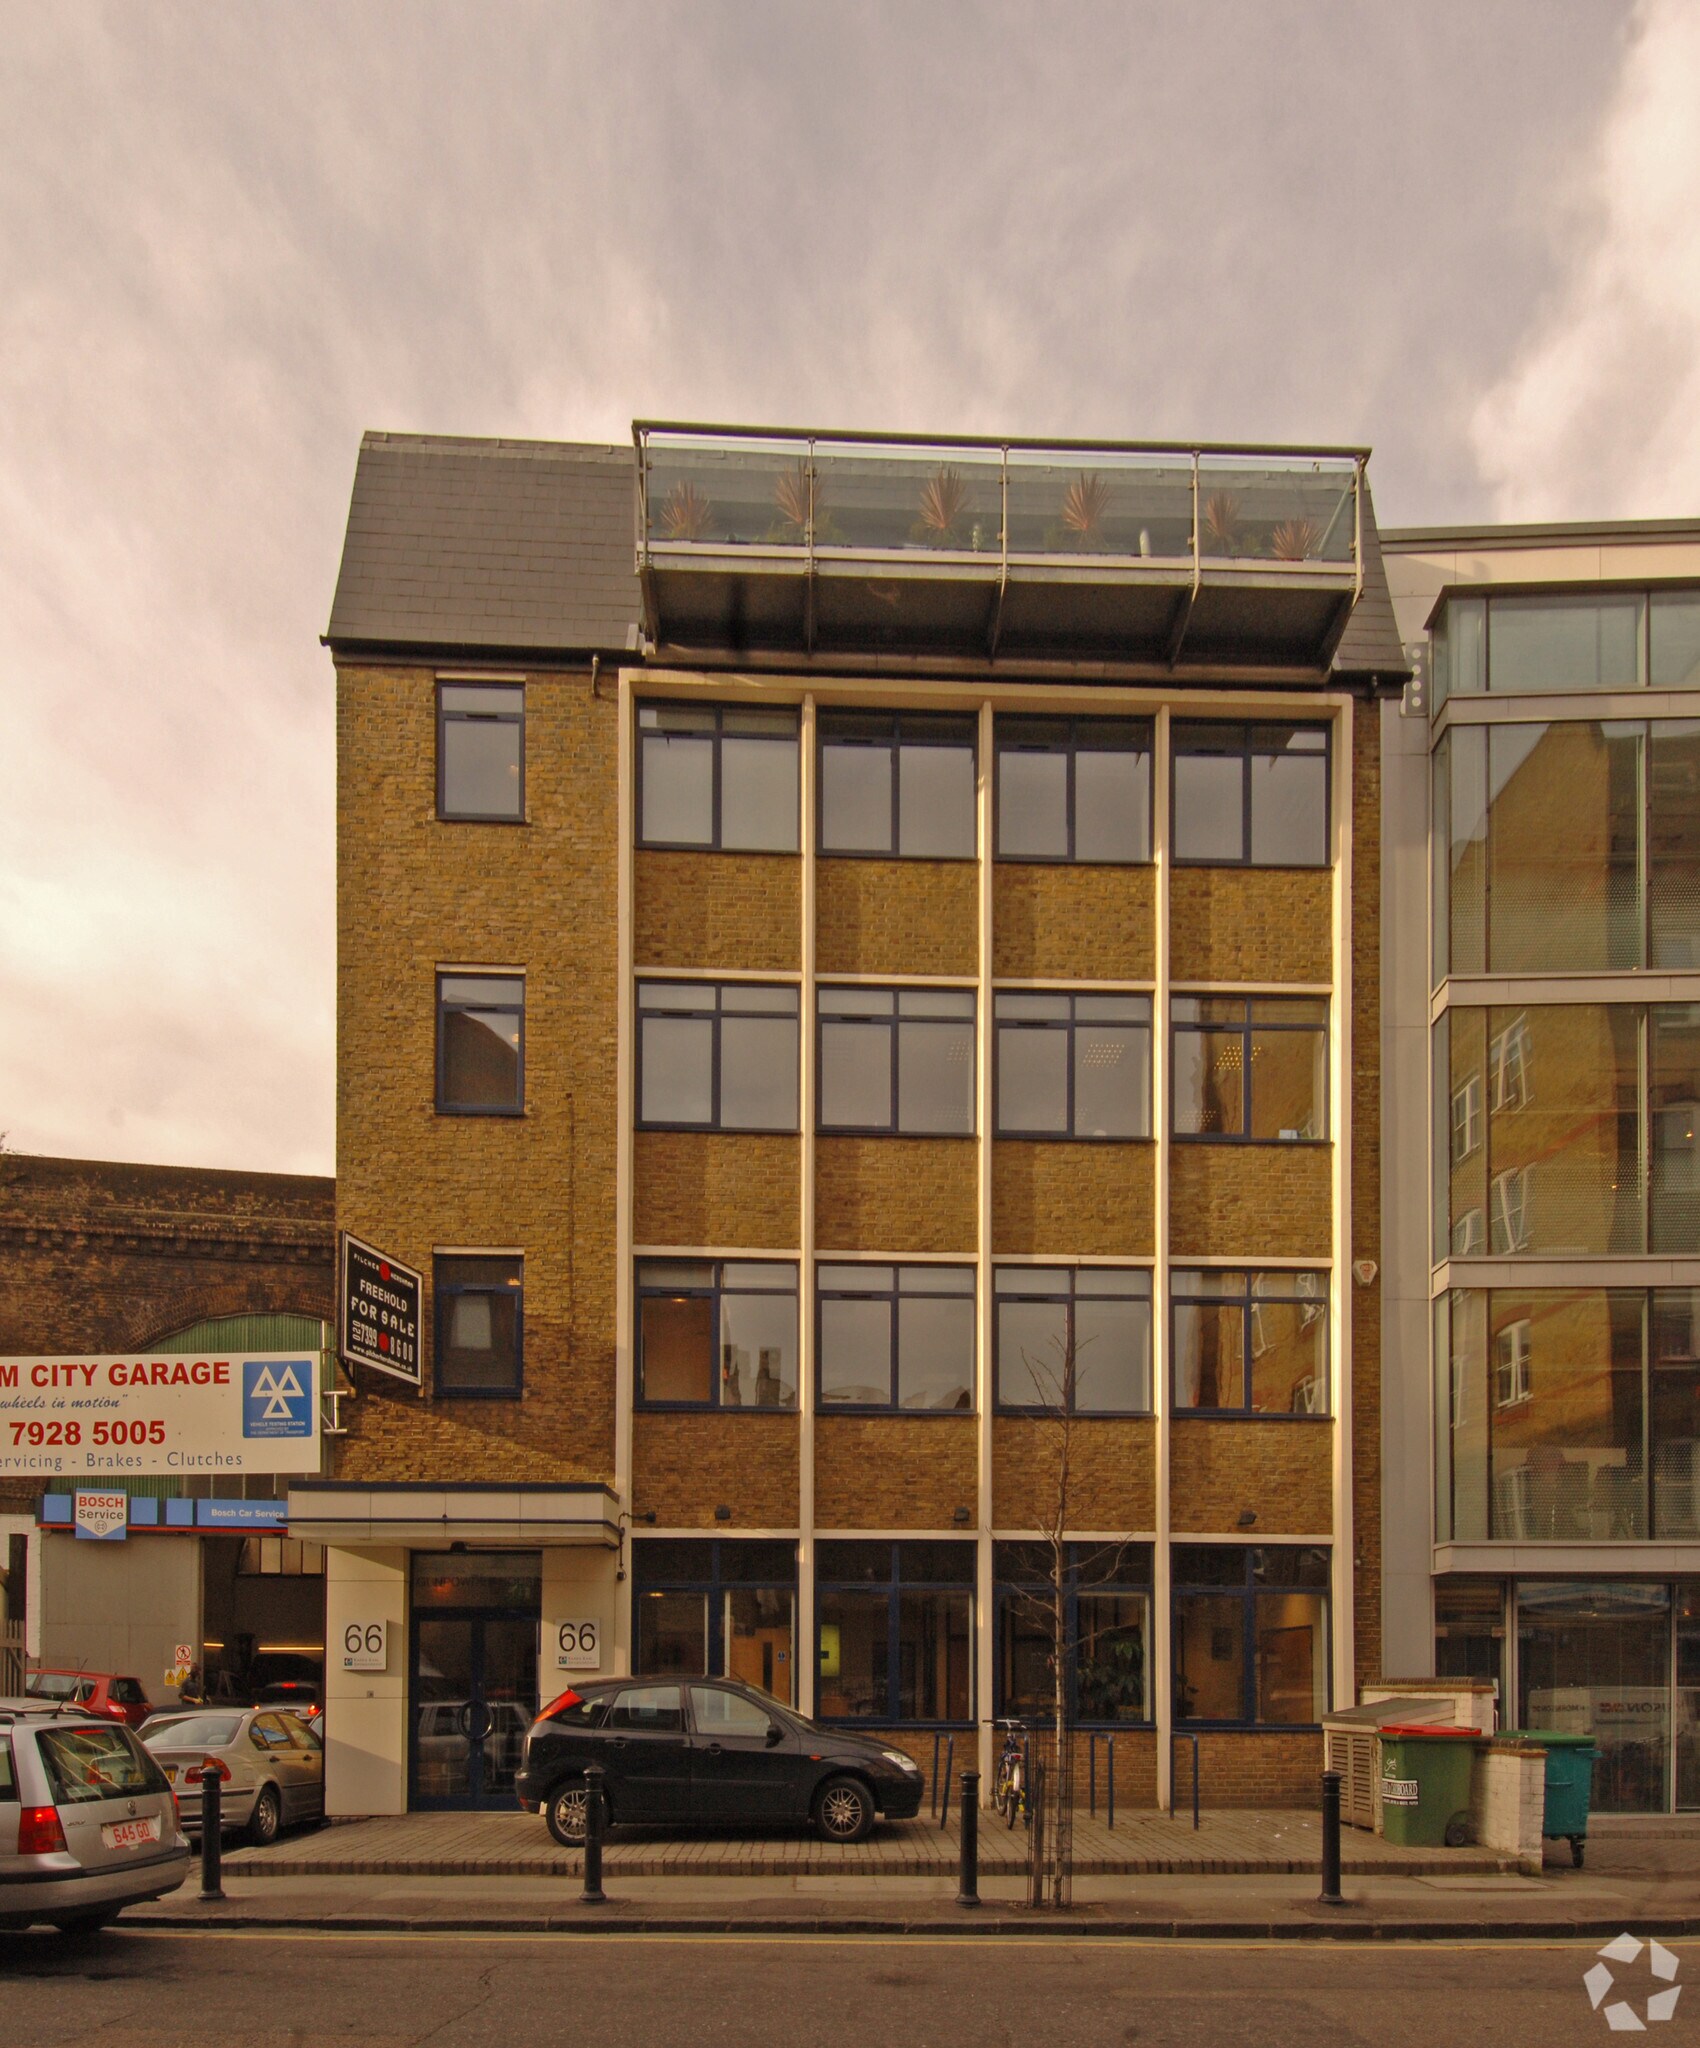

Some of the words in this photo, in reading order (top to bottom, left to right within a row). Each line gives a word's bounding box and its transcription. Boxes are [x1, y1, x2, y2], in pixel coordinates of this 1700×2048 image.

[360, 1278, 407, 1312] FREEHOLD
[351, 1296, 377, 1320] FOR
[381, 1310, 414, 1337] SALE
[352, 1320, 361, 1341] 020
[31, 1364, 98, 1387] CITY
[108, 1362, 230, 1386] GARAGE
[52, 1397, 66, 1408] in
[9, 1421, 81, 1446] 7928
[92, 1420, 165, 1445] 5005
[87, 1453, 142, 1467] Brakes
[167, 1451, 242, 1466] Clutches
[79, 1496, 124, 1508] BOSCH
[78, 1509, 124, 1520] Service
[211, 1508, 236, 1517] Bosch
[238, 1509, 252, 1517] Car
[255, 1509, 285, 1518] Service
[345, 1624, 382, 1653] 66
[559, 1623, 595, 1652] 66
[113, 1824, 136, 1843] 645
